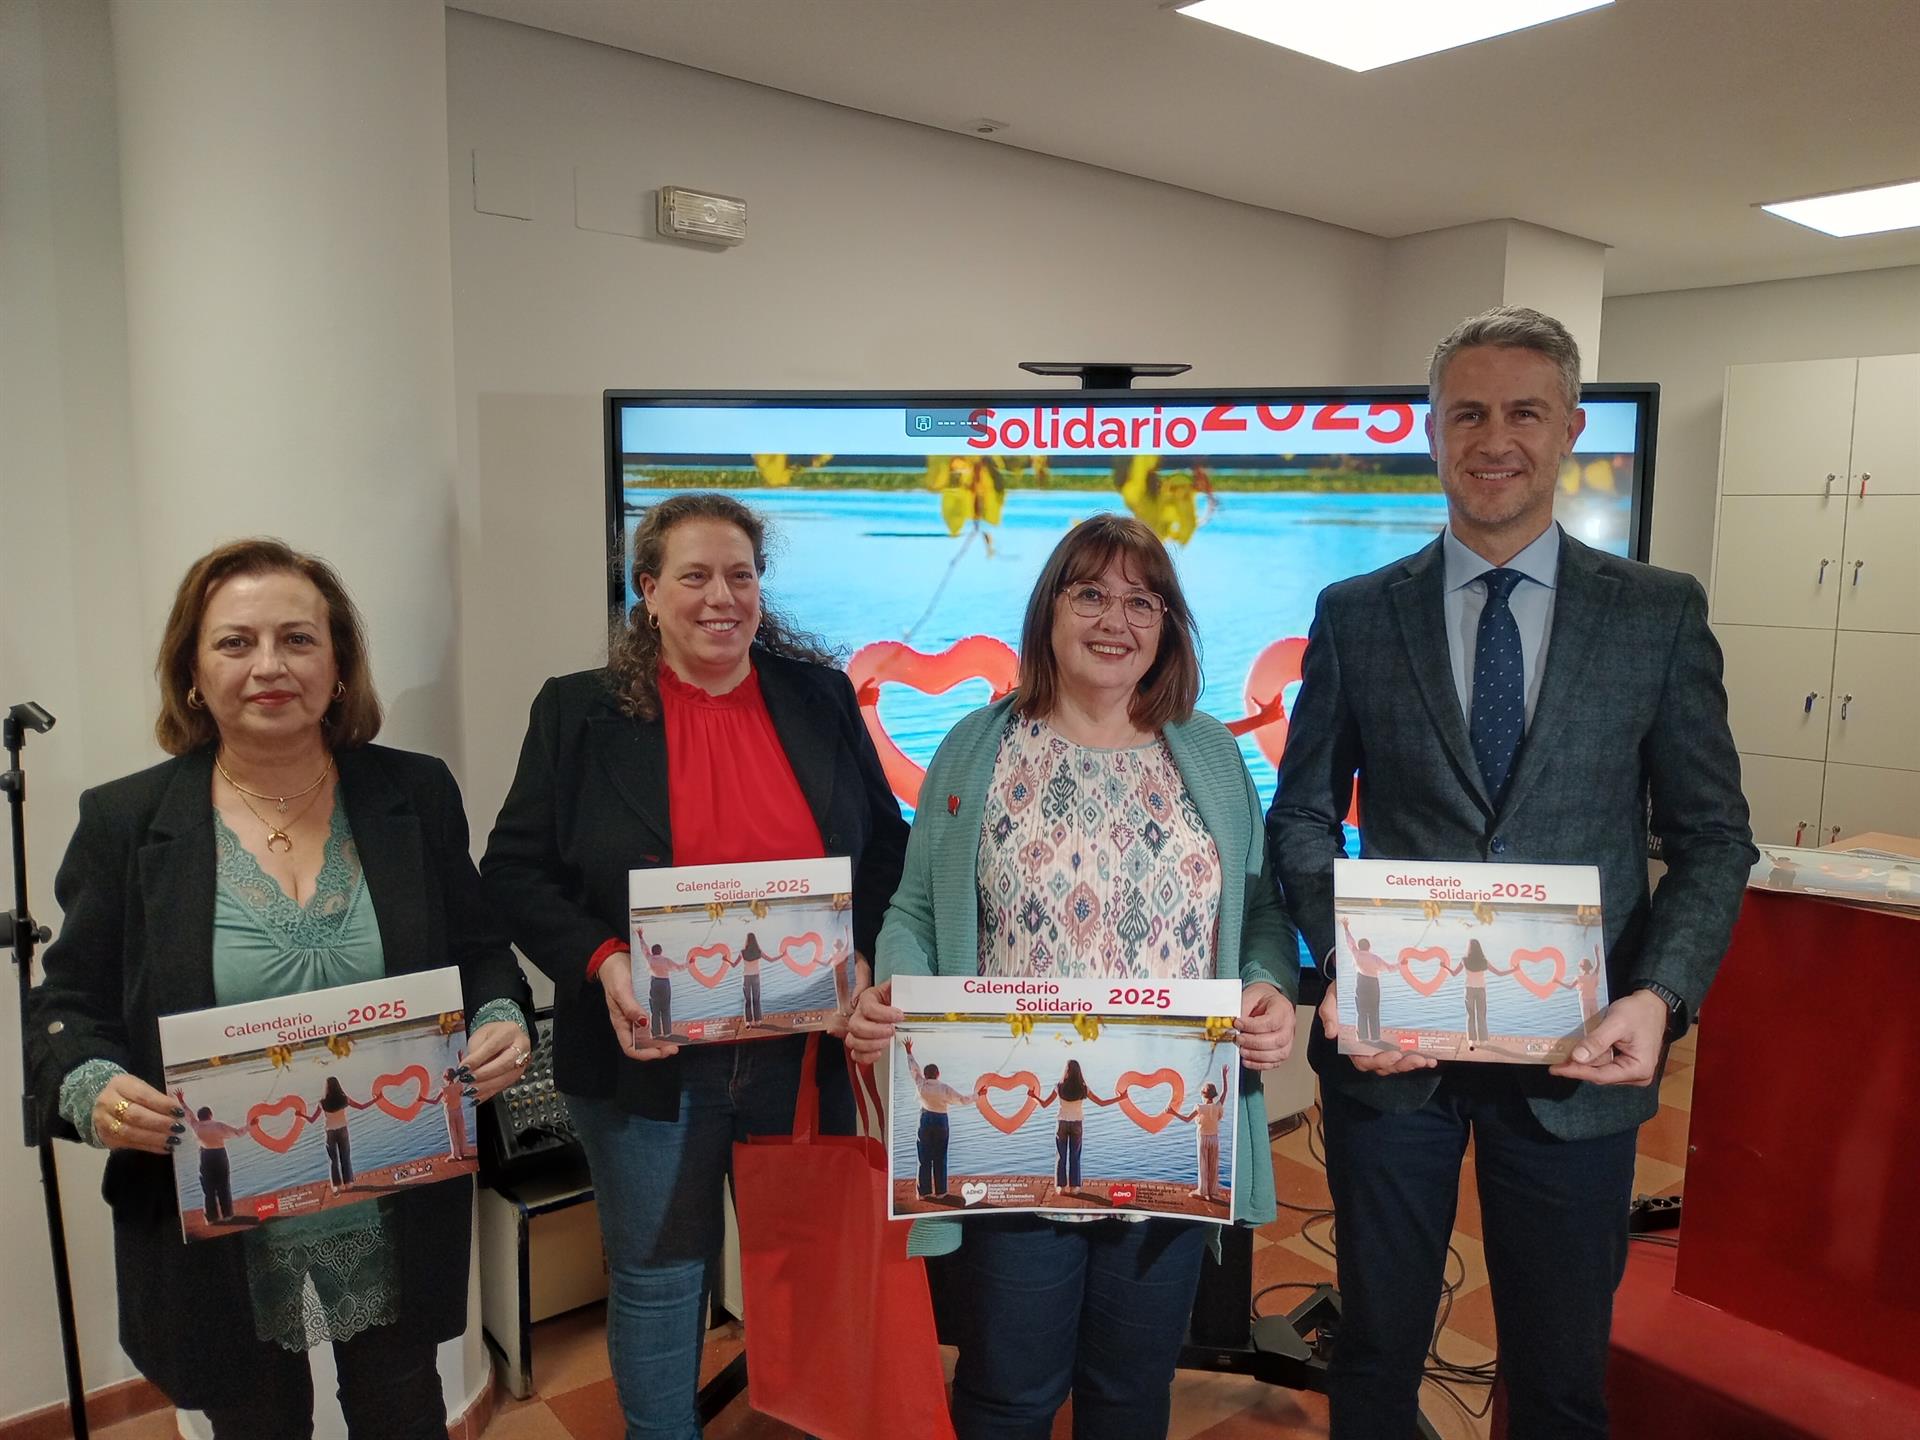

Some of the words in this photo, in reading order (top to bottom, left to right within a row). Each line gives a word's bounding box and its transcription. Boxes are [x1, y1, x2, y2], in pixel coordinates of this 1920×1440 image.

[966, 405, 1197, 449] Solidario
[676, 879, 741, 893] Calendario
[714, 888, 766, 901] Solidario
[766, 878, 810, 894] 2025
[1386, 874, 1461, 888] Calendario
[1429, 888, 1491, 901] Solidario
[1492, 882, 1547, 901] 2025
[963, 980, 1059, 995] Calendario
[1015, 998, 1093, 1013] Solidario
[1108, 988, 1171, 1009] 2025
[224, 1012, 313, 1038] Calendario
[277, 1020, 348, 1043] Solidario
[347, 1000, 407, 1025] 2025
